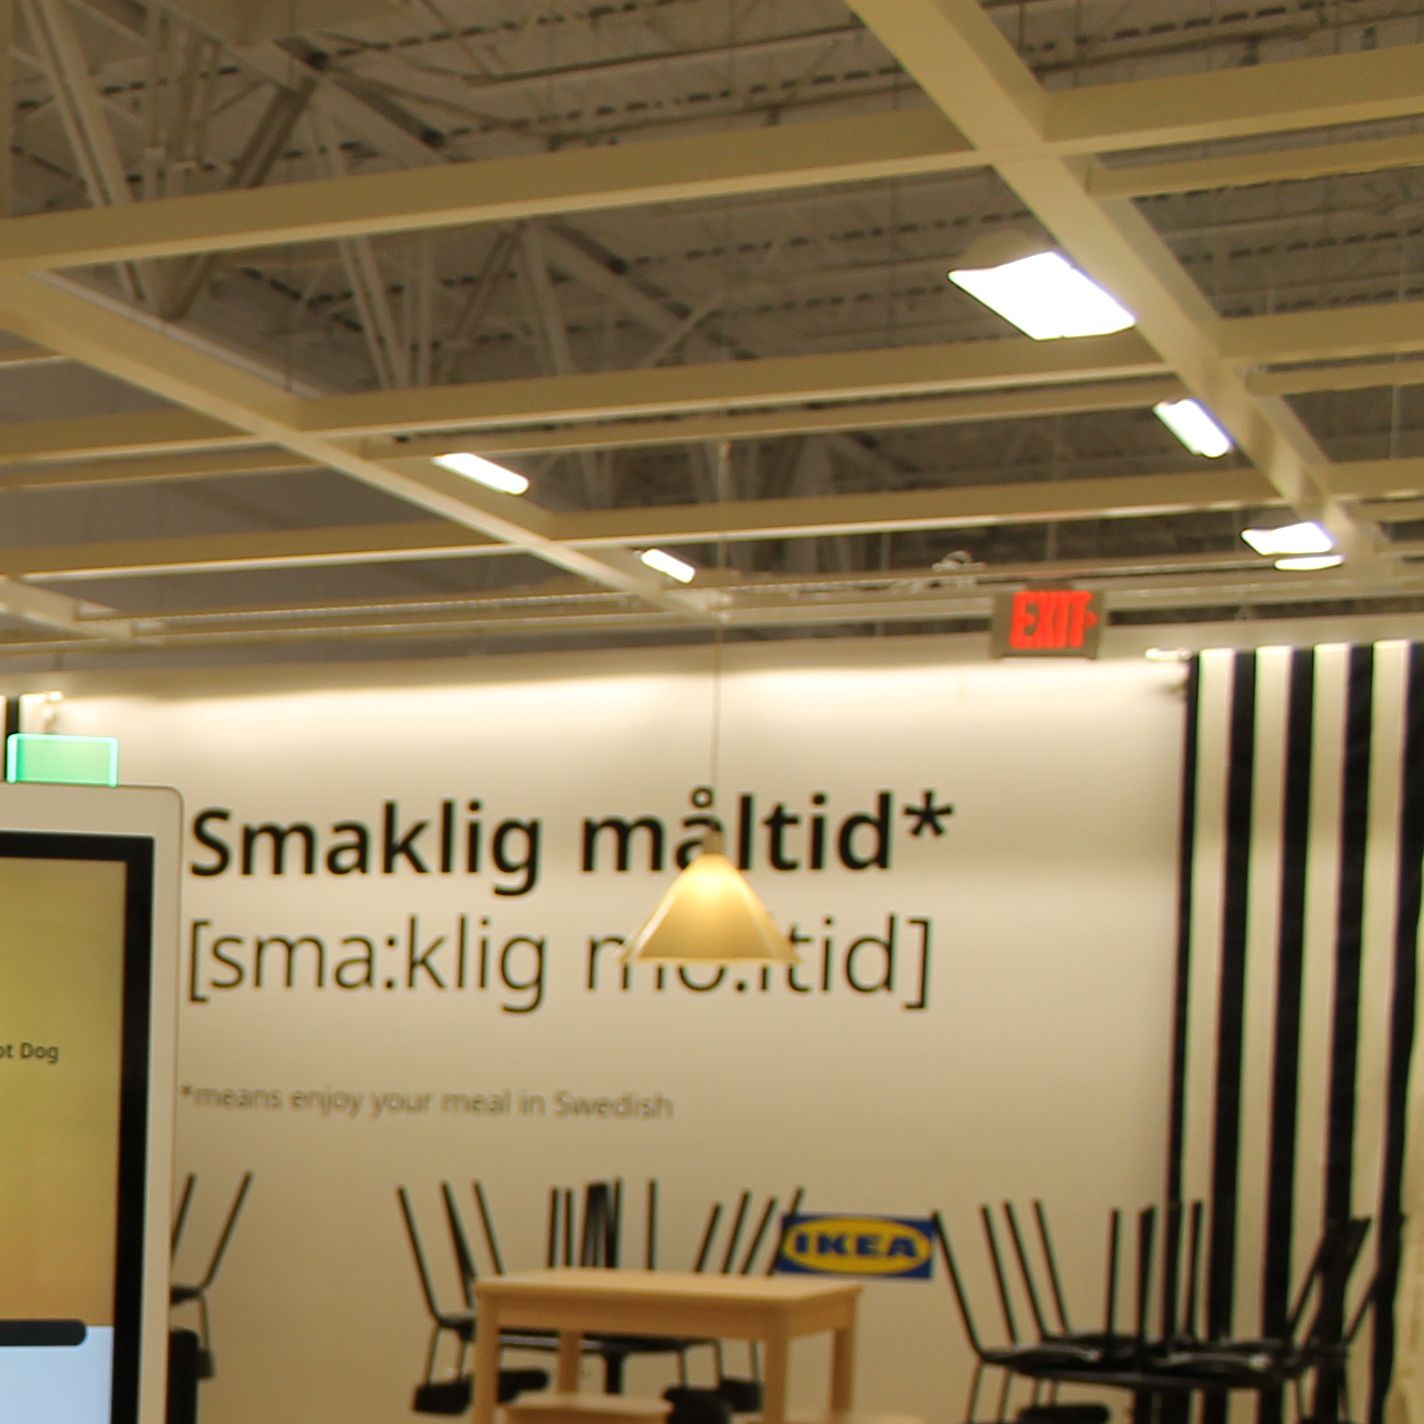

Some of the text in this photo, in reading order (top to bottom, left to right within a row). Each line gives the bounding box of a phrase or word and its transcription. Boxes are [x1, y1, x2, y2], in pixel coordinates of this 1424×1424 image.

[1009, 590, 1092, 649] EXIT
[190, 799, 543, 898] Smaklig
[188, 914, 545, 1015] [sma:klig
[20, 1042, 59, 1064] Dog
[289, 1087, 361, 1118] enjoy
[369, 1091, 434, 1120] your
[439, 1088, 512, 1113] meal
[517, 1089, 546, 1114] in
[553, 1089, 674, 1118] Swedish
